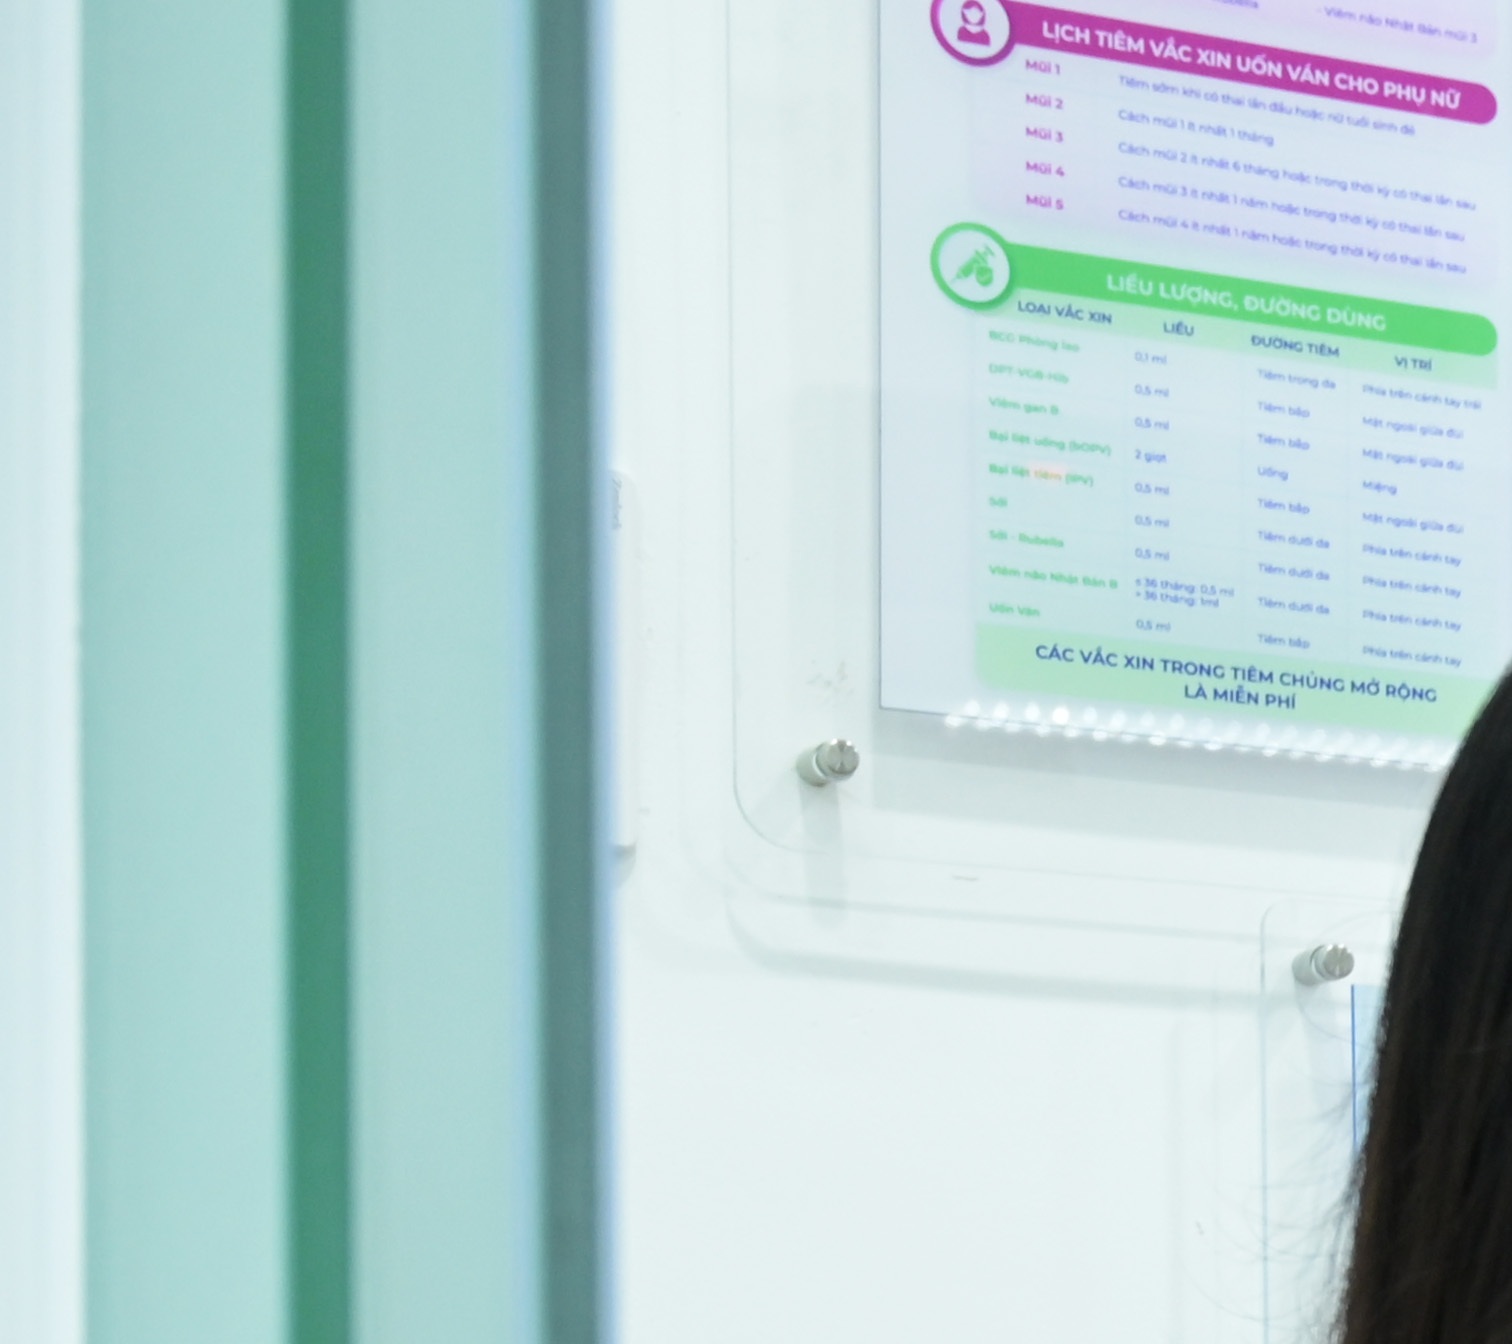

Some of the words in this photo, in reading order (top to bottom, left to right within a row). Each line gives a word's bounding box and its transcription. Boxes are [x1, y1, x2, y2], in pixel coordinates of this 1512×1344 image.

[1042, 21, 1090, 44] LỊCH
[1095, 30, 1145, 54] TIÊM
[1150, 37, 1192, 62] VẮC
[1197, 48, 1232, 69] XIN
[1236, 55, 1282, 78] UỐN
[1286, 64, 1330, 86] VÁN
[1334, 73, 1379, 94] CHO
[1383, 81, 1426, 105] PHỤ
[1430, 89, 1460, 109] NỮ
[1036, 644, 1074, 662] CÁC
[1080, 647, 1117, 667] VẮC
[1124, 655, 1155, 670] XIN
[1160, 659, 1224, 678] TRONG
[1231, 666, 1274, 687] TIÊM
[1279, 672, 1344, 691] CHỦNG
[1351, 679, 1380, 695] MỞ
[1385, 683, 1436, 702] RỘNG
[1184, 684, 1207, 699] LÀ
[1213, 685, 1259, 704] MIỄN
[1265, 693, 1295, 708] PHÍ
